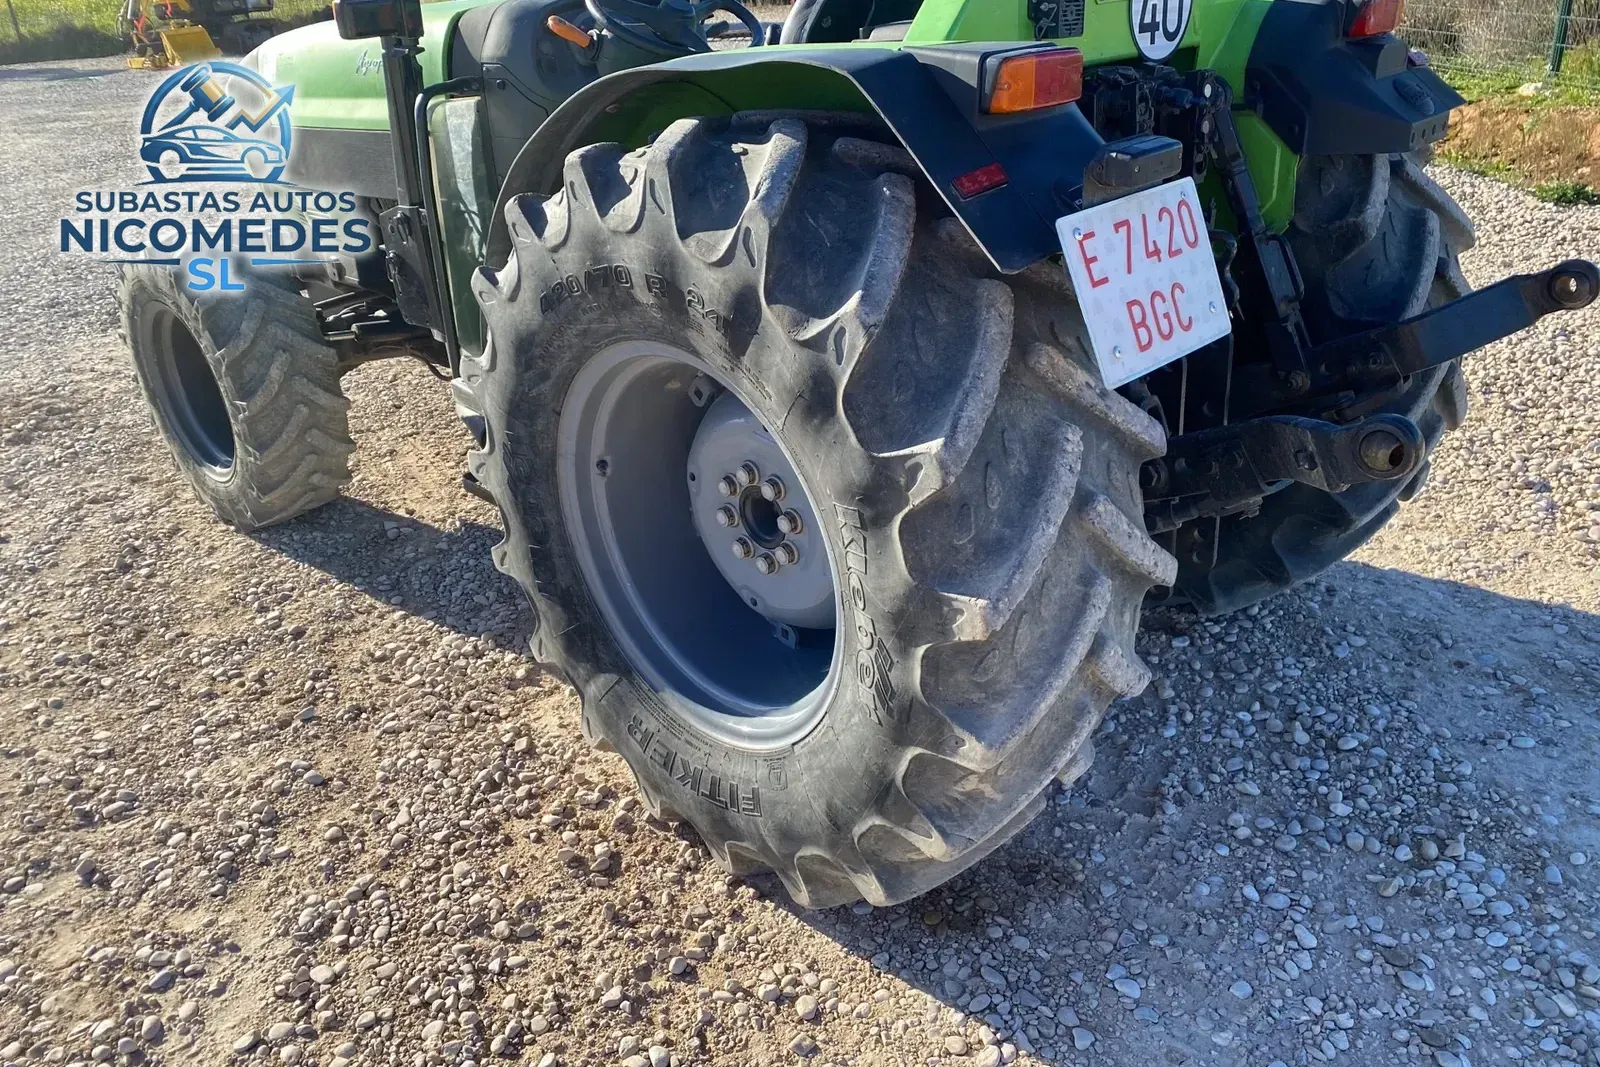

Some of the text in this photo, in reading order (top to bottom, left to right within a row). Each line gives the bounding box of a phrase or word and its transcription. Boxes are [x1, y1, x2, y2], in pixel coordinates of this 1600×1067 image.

[1138, 0, 1184, 45] 40
[1077, 199, 1200, 289] E 7420
[539, 263, 634, 316] 420/70
[644, 271, 669, 300] R
[685, 284, 729, 336] 24
[1125, 282, 1194, 353] BGC
[626, 713, 763, 818] FITKER
